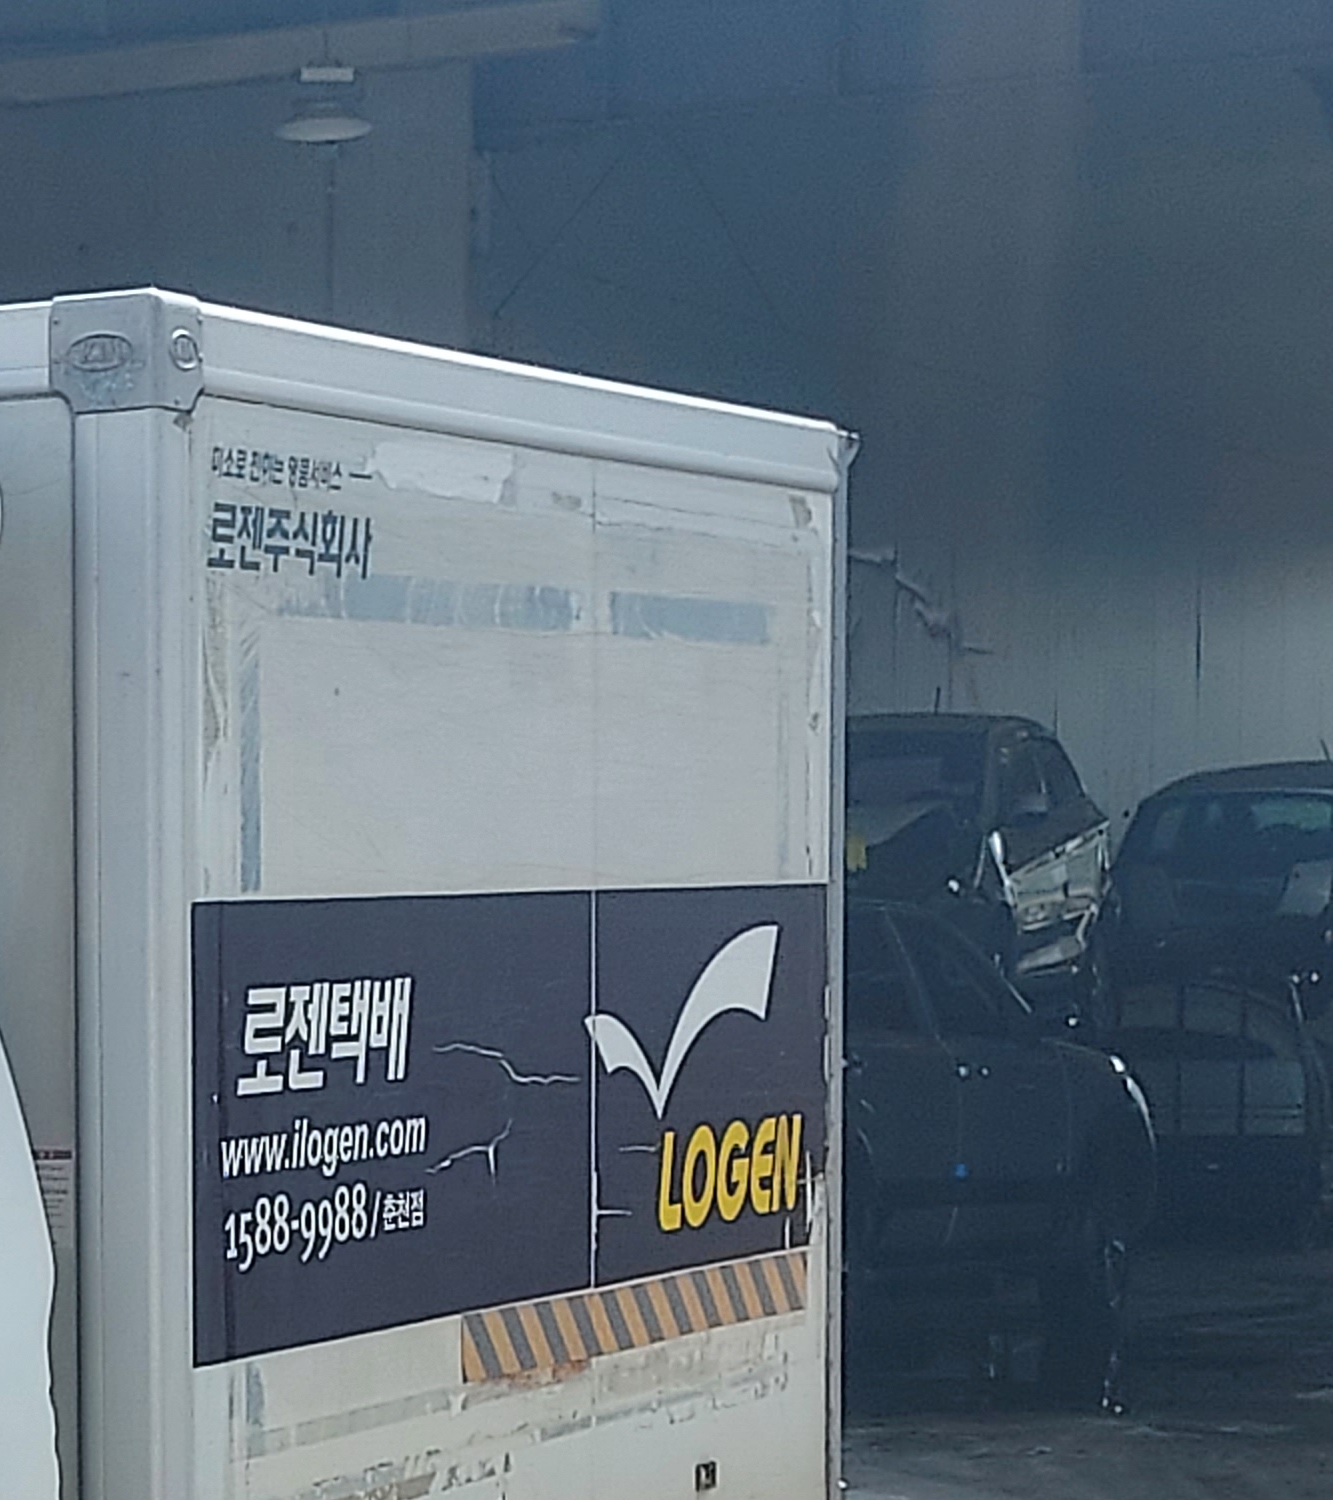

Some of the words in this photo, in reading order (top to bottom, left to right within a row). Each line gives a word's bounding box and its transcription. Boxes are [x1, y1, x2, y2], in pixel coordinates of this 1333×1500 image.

[206, 501, 373, 580] 로젠주식회사
[236, 976, 413, 1097] 로젠택배
[221, 1115, 427, 1178] www.ilogen.com
[657, 1113, 802, 1232] LOGEN
